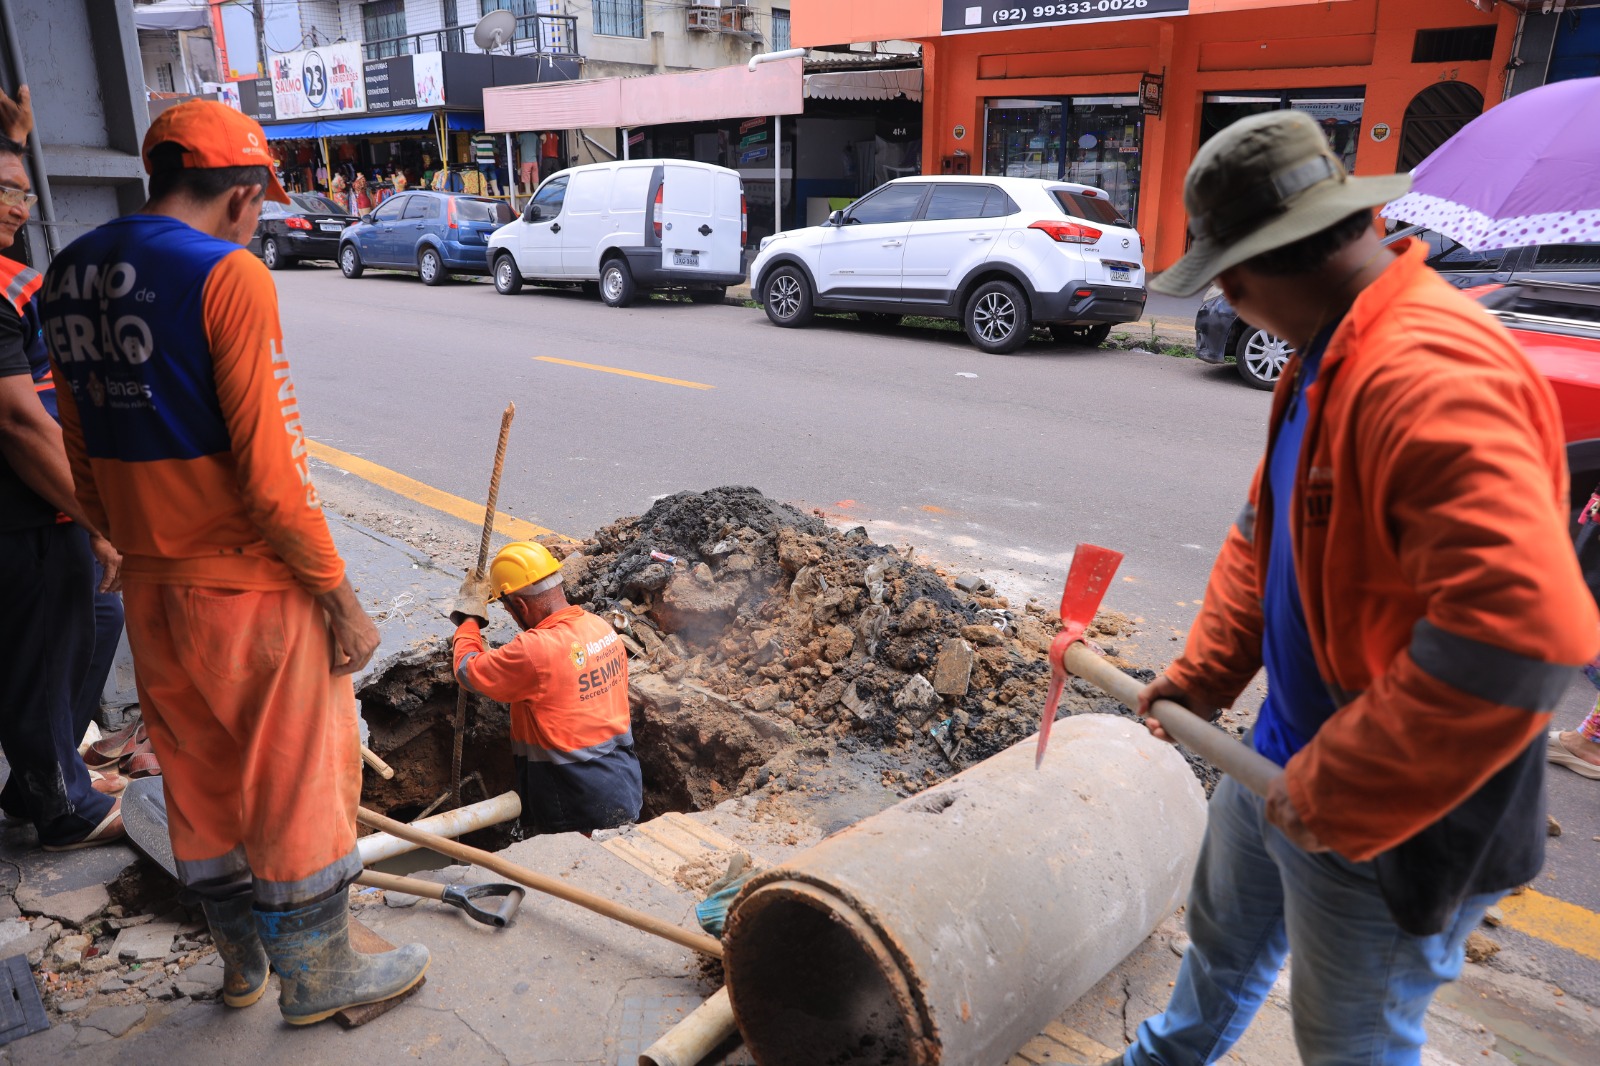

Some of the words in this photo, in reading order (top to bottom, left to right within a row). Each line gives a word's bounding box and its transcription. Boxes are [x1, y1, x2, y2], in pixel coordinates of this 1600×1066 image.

[992, 8, 1027, 23] (92)
[1033, 0, 1148, 18] 99333-0026
[275, 78, 302, 94] SALMO
[305, 65, 325, 96] 23
[329, 72, 359, 84] VARIEDADES
[135, 288, 156, 303] de
[586, 630, 618, 656] Manaus
